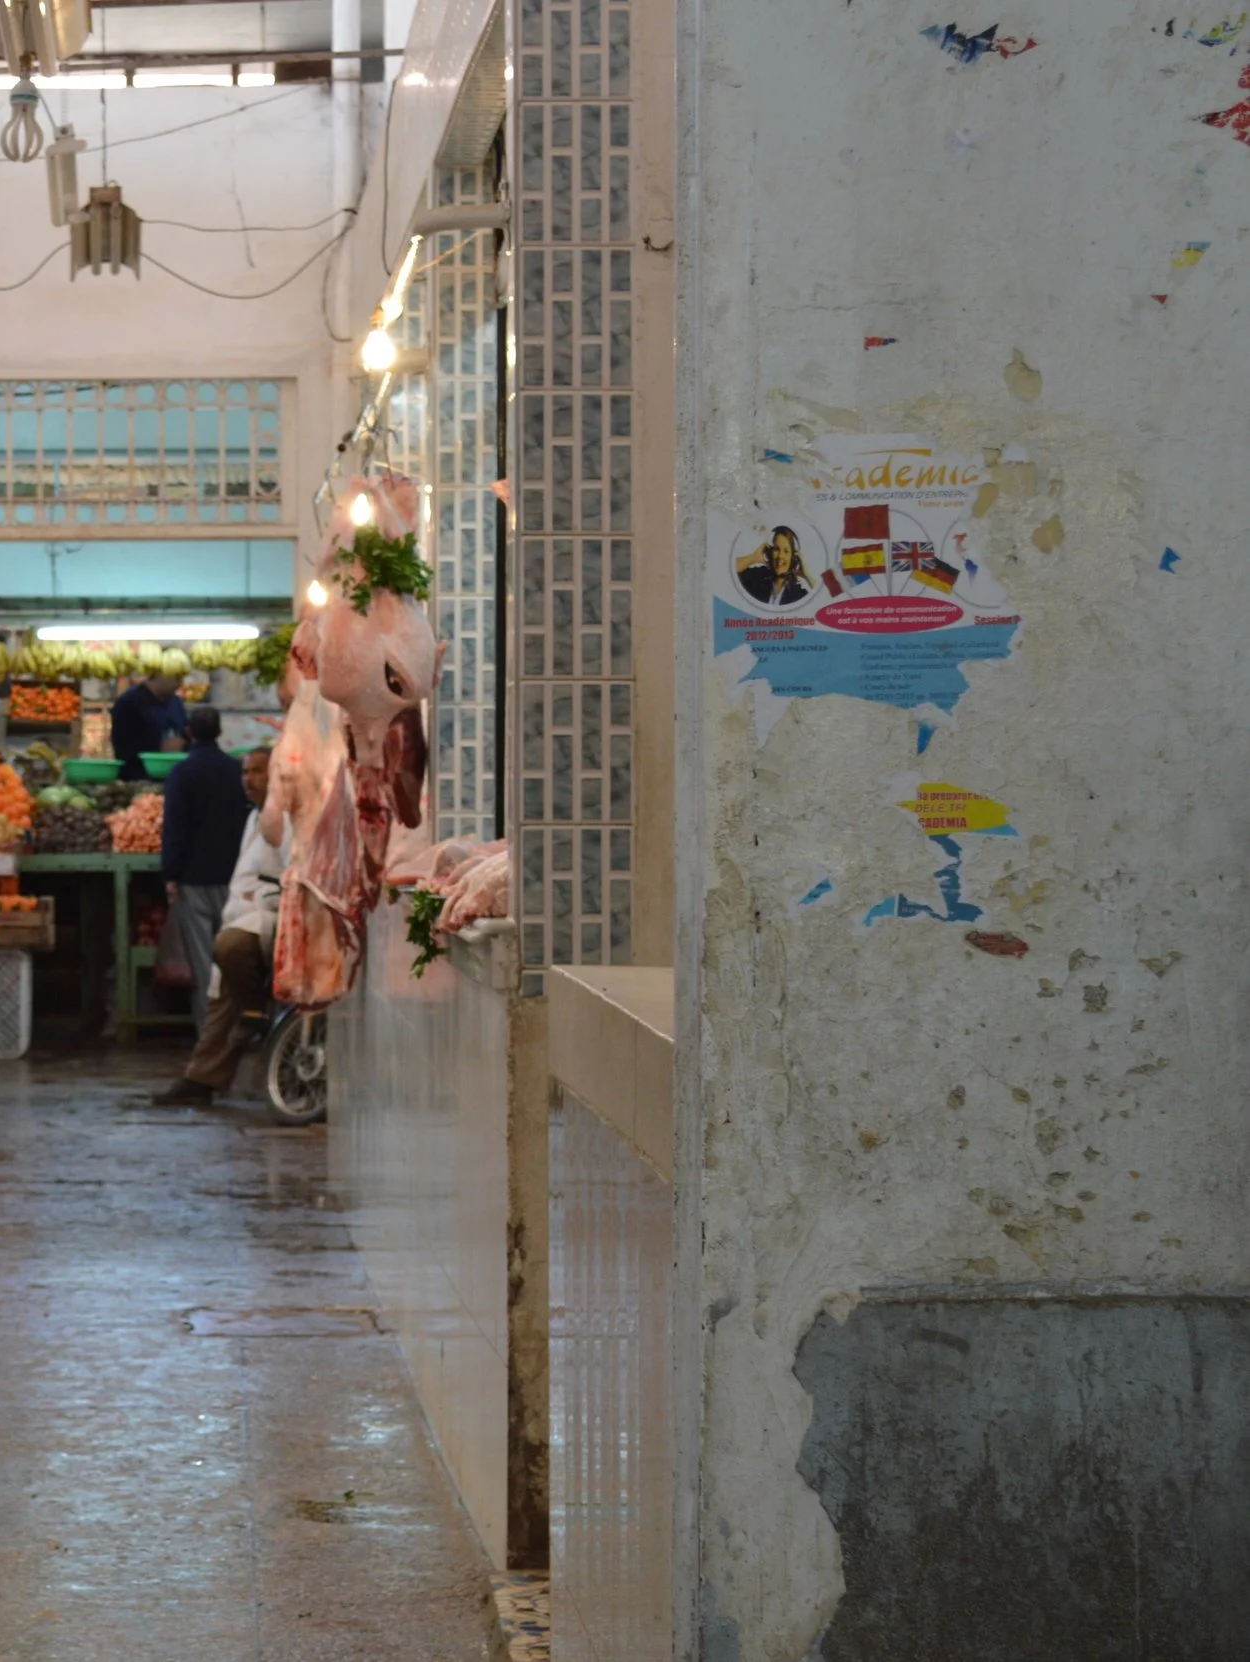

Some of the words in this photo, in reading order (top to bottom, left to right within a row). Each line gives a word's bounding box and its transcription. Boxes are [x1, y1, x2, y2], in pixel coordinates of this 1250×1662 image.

[844, 606, 883, 614] formation
[896, 605, 957, 613] communication
[725, 617, 753, 628] Année
[756, 615, 815, 626] Académique
[838, 617, 851, 625] est
[876, 616, 900, 624] mains
[901, 615, 947, 623] maintenant
[974, 615, 1011, 626] Session
